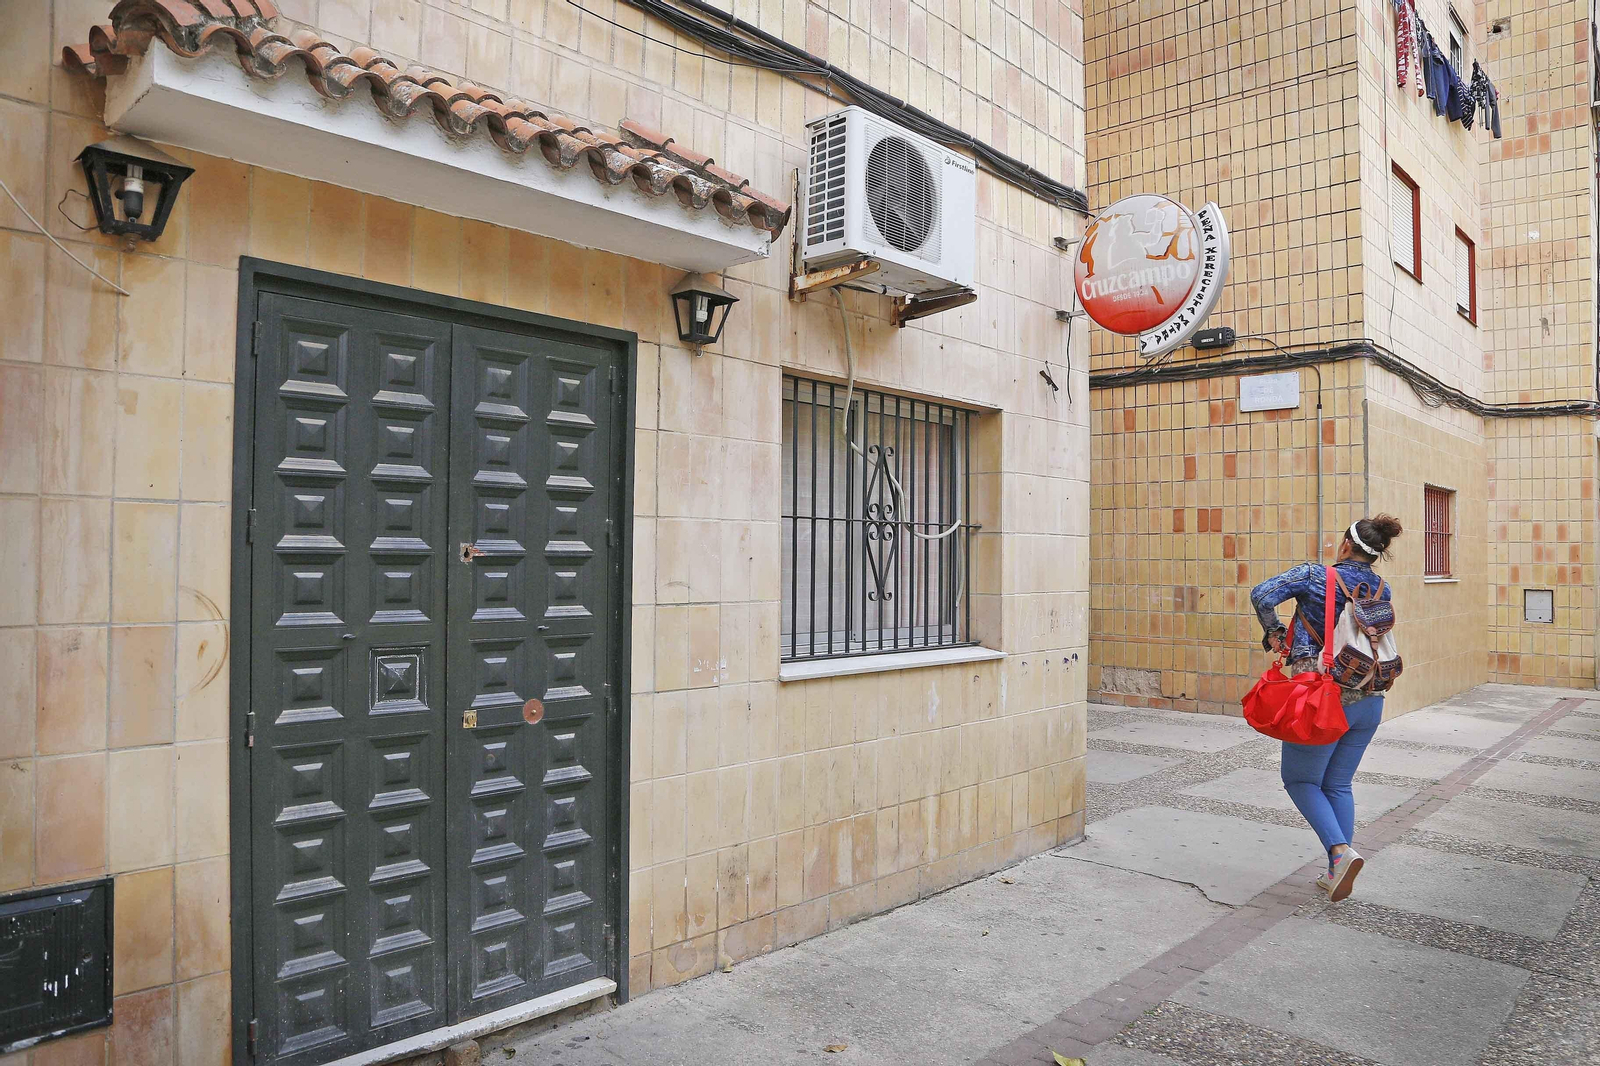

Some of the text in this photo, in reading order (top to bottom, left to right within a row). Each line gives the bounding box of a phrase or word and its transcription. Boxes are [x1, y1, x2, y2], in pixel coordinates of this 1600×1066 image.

[1197, 209, 1216, 242] PEÑA
[1081, 261, 1192, 301] Cruzcampo
[1112, 292, 1131, 302] DESDE
[1187, 246, 1218, 316] XERECISTA
[1140, 313, 1190, 351] MATRAA
[1254, 395, 1284, 404] RONDA
